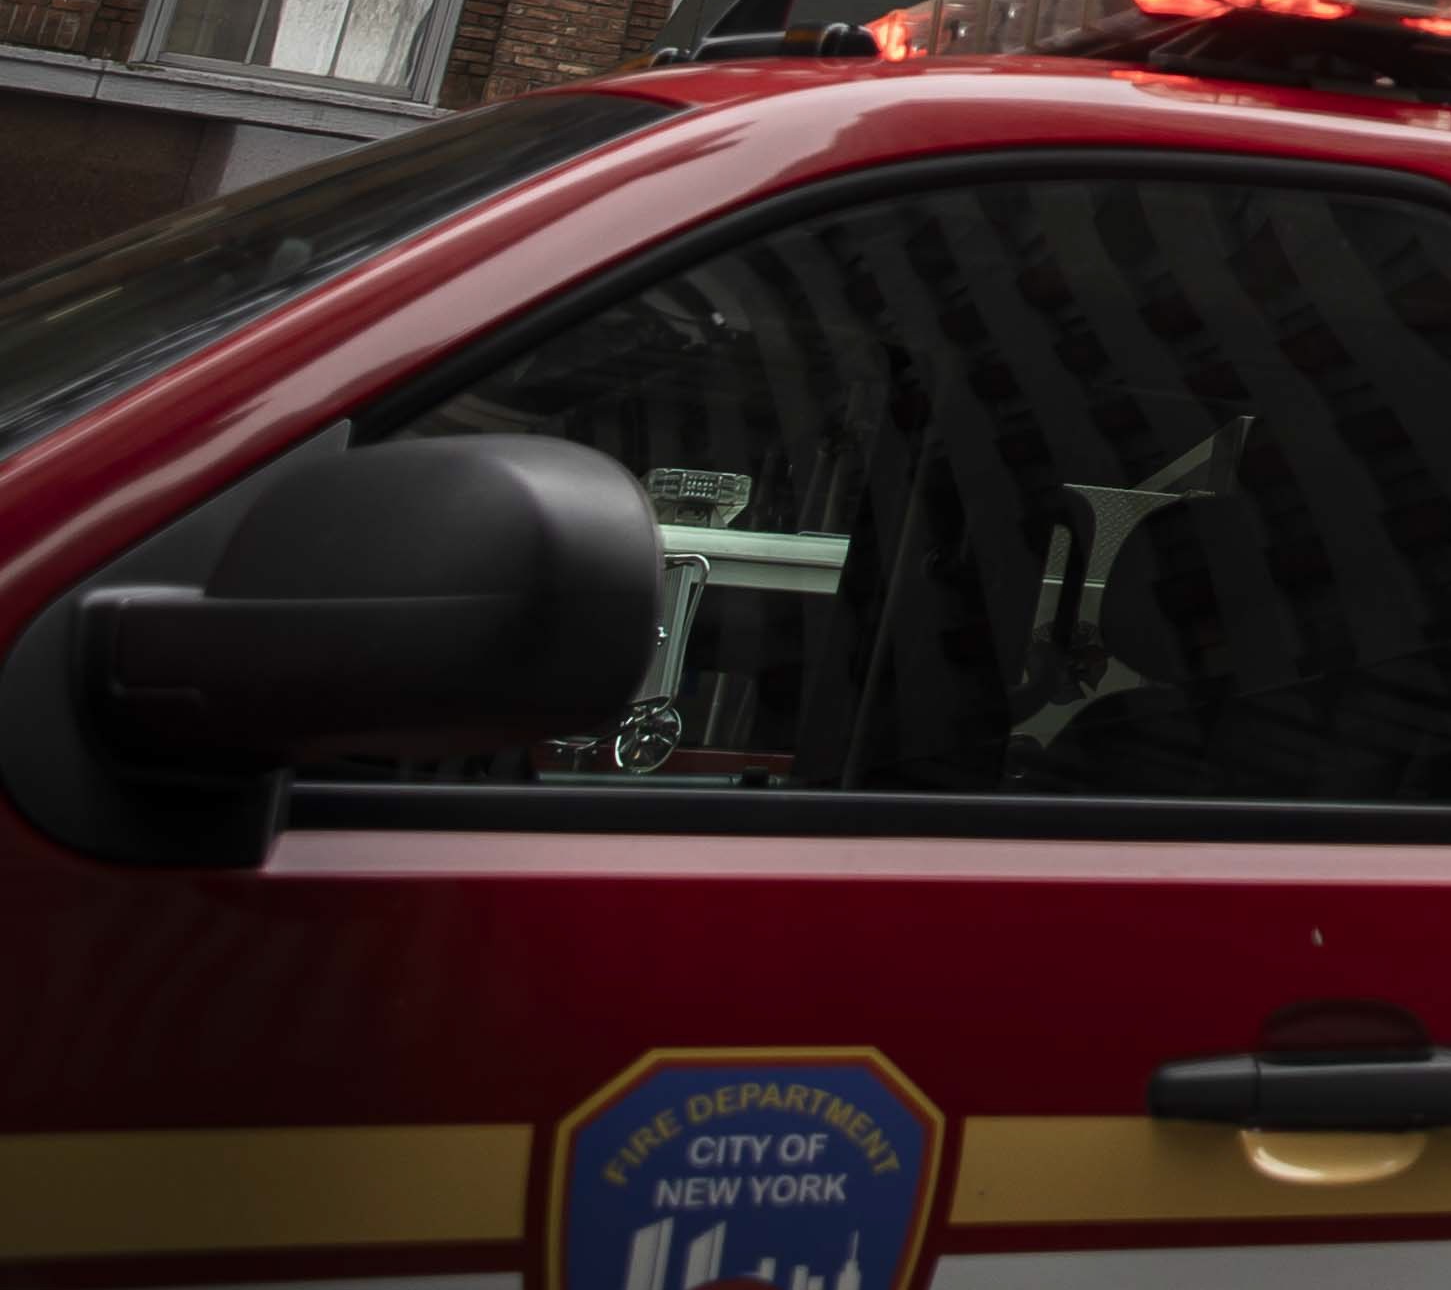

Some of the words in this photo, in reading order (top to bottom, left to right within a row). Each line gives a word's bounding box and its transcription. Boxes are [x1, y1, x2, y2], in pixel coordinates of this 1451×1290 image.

[603, 1108, 684, 1186] FIRE
[686, 1081, 900, 1176] DEPARTMENT
[687, 1135, 773, 1167] CITY
[778, 1132, 828, 1164] OF
[654, 1177, 741, 1209] NEW
[750, 1173, 849, 1204] YORK
